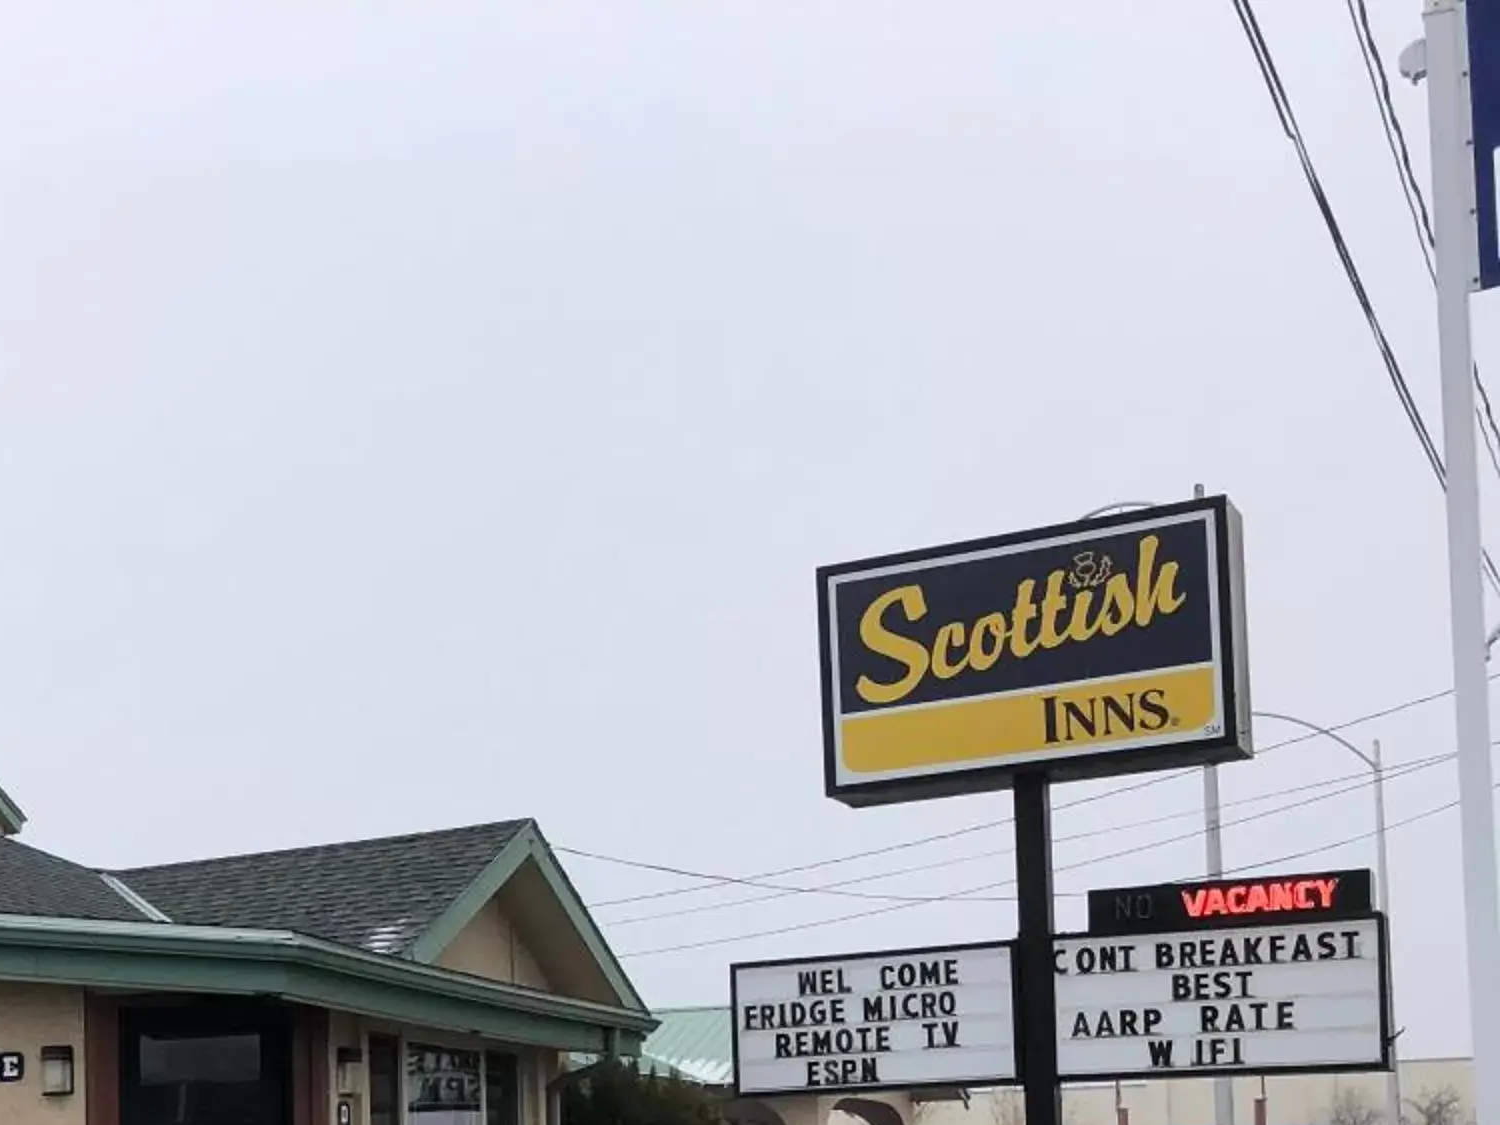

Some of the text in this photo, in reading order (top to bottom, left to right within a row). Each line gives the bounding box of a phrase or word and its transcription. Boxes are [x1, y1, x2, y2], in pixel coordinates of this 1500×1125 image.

[856, 535, 1187, 703] Scottish
[1115, 878, 1338, 920] NO VACANCY
[1053, 931, 1360, 973] CONT BREAKFAST
[1171, 971, 1253, 1000] BEST
[744, 991, 957, 1029] FRIDGE MICRO
[1072, 1002, 1295, 1037] AARP RATE
[775, 1021, 960, 1058] REMOTE TV
[806, 1058, 880, 1086] ESPN
